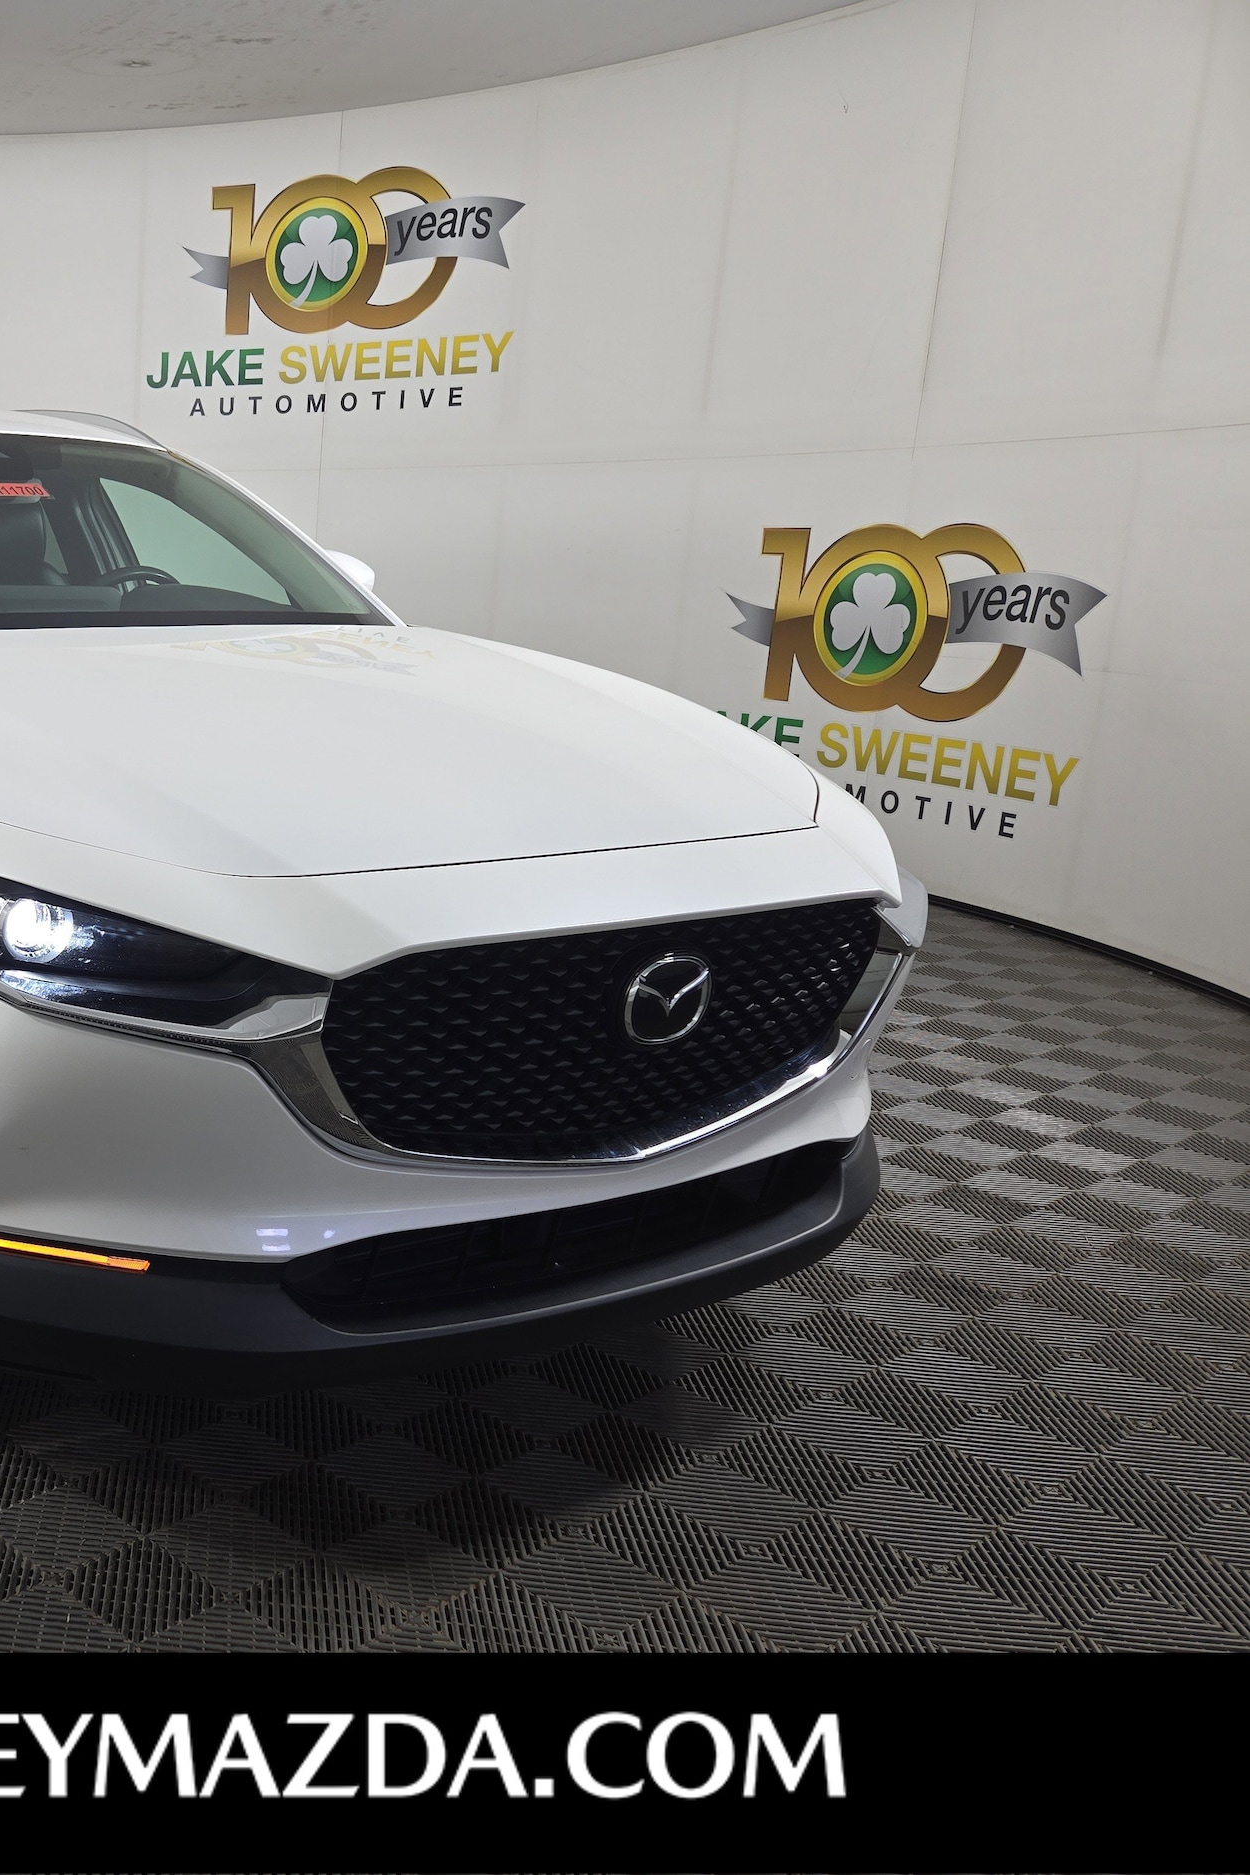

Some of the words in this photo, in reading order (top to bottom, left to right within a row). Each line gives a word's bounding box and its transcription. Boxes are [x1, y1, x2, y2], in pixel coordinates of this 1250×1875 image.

[211, 165, 458, 335] 100
[394, 205, 493, 256] years
[147, 347, 265, 389] JAKE
[279, 331, 515, 385] SWEENEY
[190, 386, 463, 417] AUTOMOTIVE
[761, 523, 1027, 723] 100
[955, 583, 1070, 635] years
[817, 722, 1080, 807] SWEENEY
[845, 783, 1017, 839] MOTIVE
